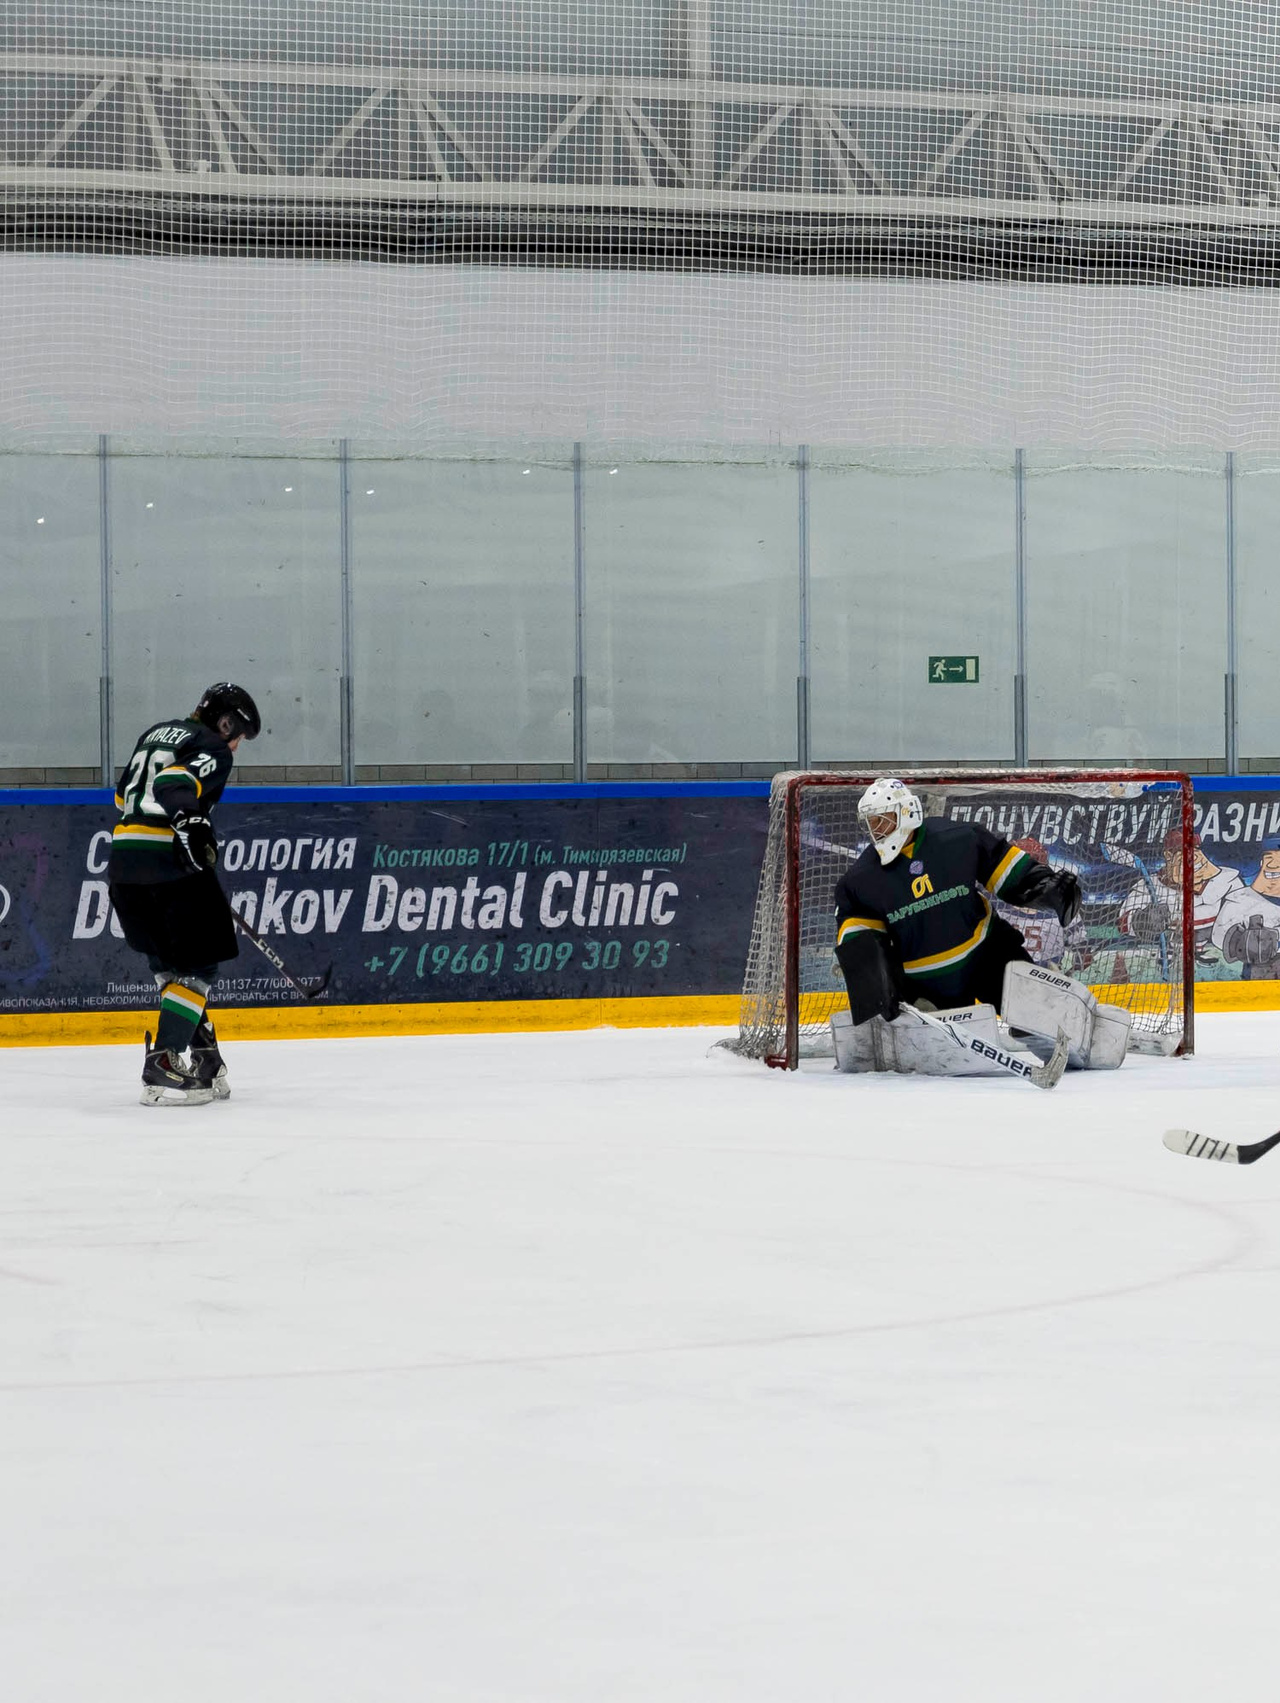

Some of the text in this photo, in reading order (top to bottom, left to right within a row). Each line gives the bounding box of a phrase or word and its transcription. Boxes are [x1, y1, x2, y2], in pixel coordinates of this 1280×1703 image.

[189, 753, 218, 778] 26
[86, 830, 358, 875] Сология
[372, 844, 480, 868] Костякова
[487, 840, 529, 867] 17/1
[362, 872, 528, 933] Dental
[538, 869, 680, 929] Clinic
[364, 939, 670, 979] +7 (966) 309 30 93
[1029, 968, 1072, 990] BAUER
